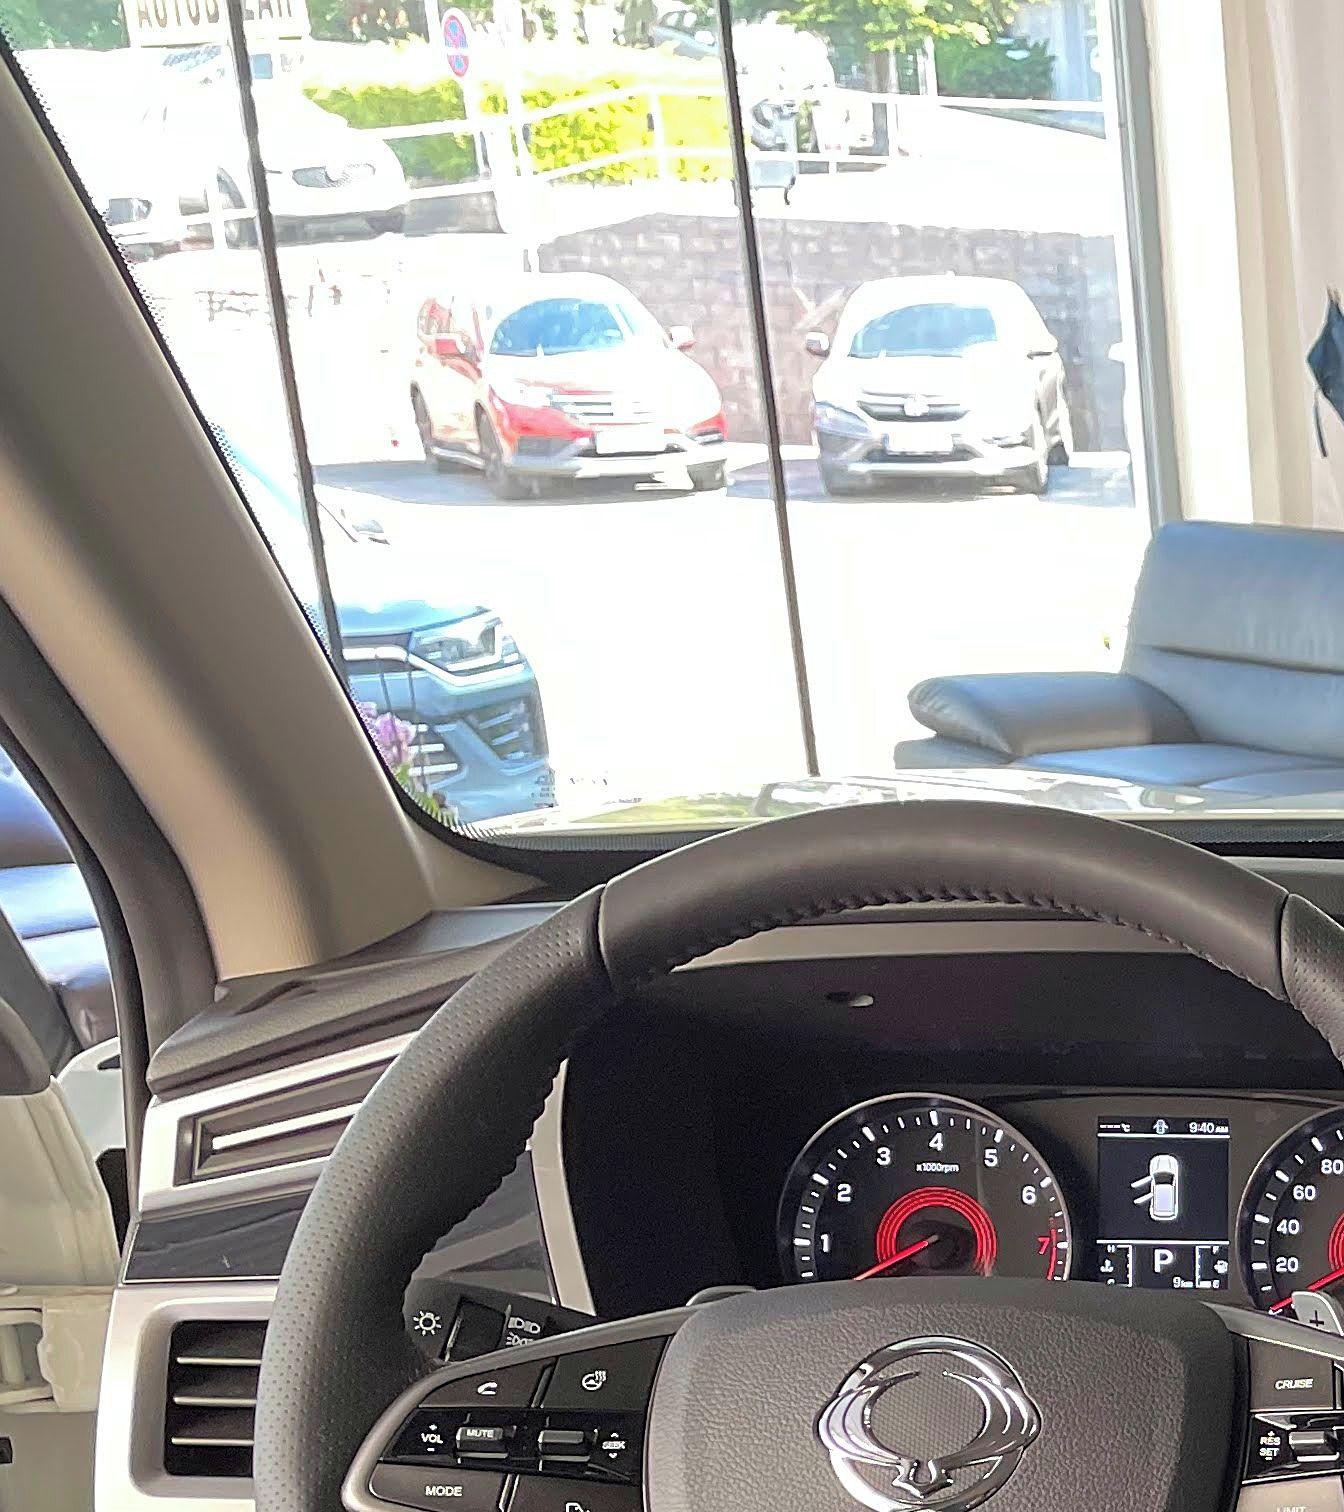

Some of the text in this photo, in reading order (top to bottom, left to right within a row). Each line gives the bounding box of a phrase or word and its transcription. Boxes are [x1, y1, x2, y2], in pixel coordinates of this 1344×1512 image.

[929, 1132, 943, 1150] 4
[877, 1147, 891, 1165] 3
[985, 1149, 998, 1167] 5
[1321, 1159, 1343, 1174] 80
[837, 1184, 851, 1201] 2
[1022, 1186, 1036, 1204] 6
[1293, 1185, 1315, 1200] 60
[1276, 1220, 1299, 1234] 40
[821, 1234, 829, 1252] 1
[1038, 1237, 1050, 1254] 7
[1154, 1249, 1173, 1273] P
[1276, 1257, 1298, 1272] 20
[1275, 1378, 1313, 1389] CRUISE
[421, 1433, 443, 1444] VOL
[467, 1429, 494, 1438] MUTE
[1260, 1436, 1280, 1446] RES
[1260, 1448, 1279, 1457] SET
[425, 1485, 462, 1497] MODE
